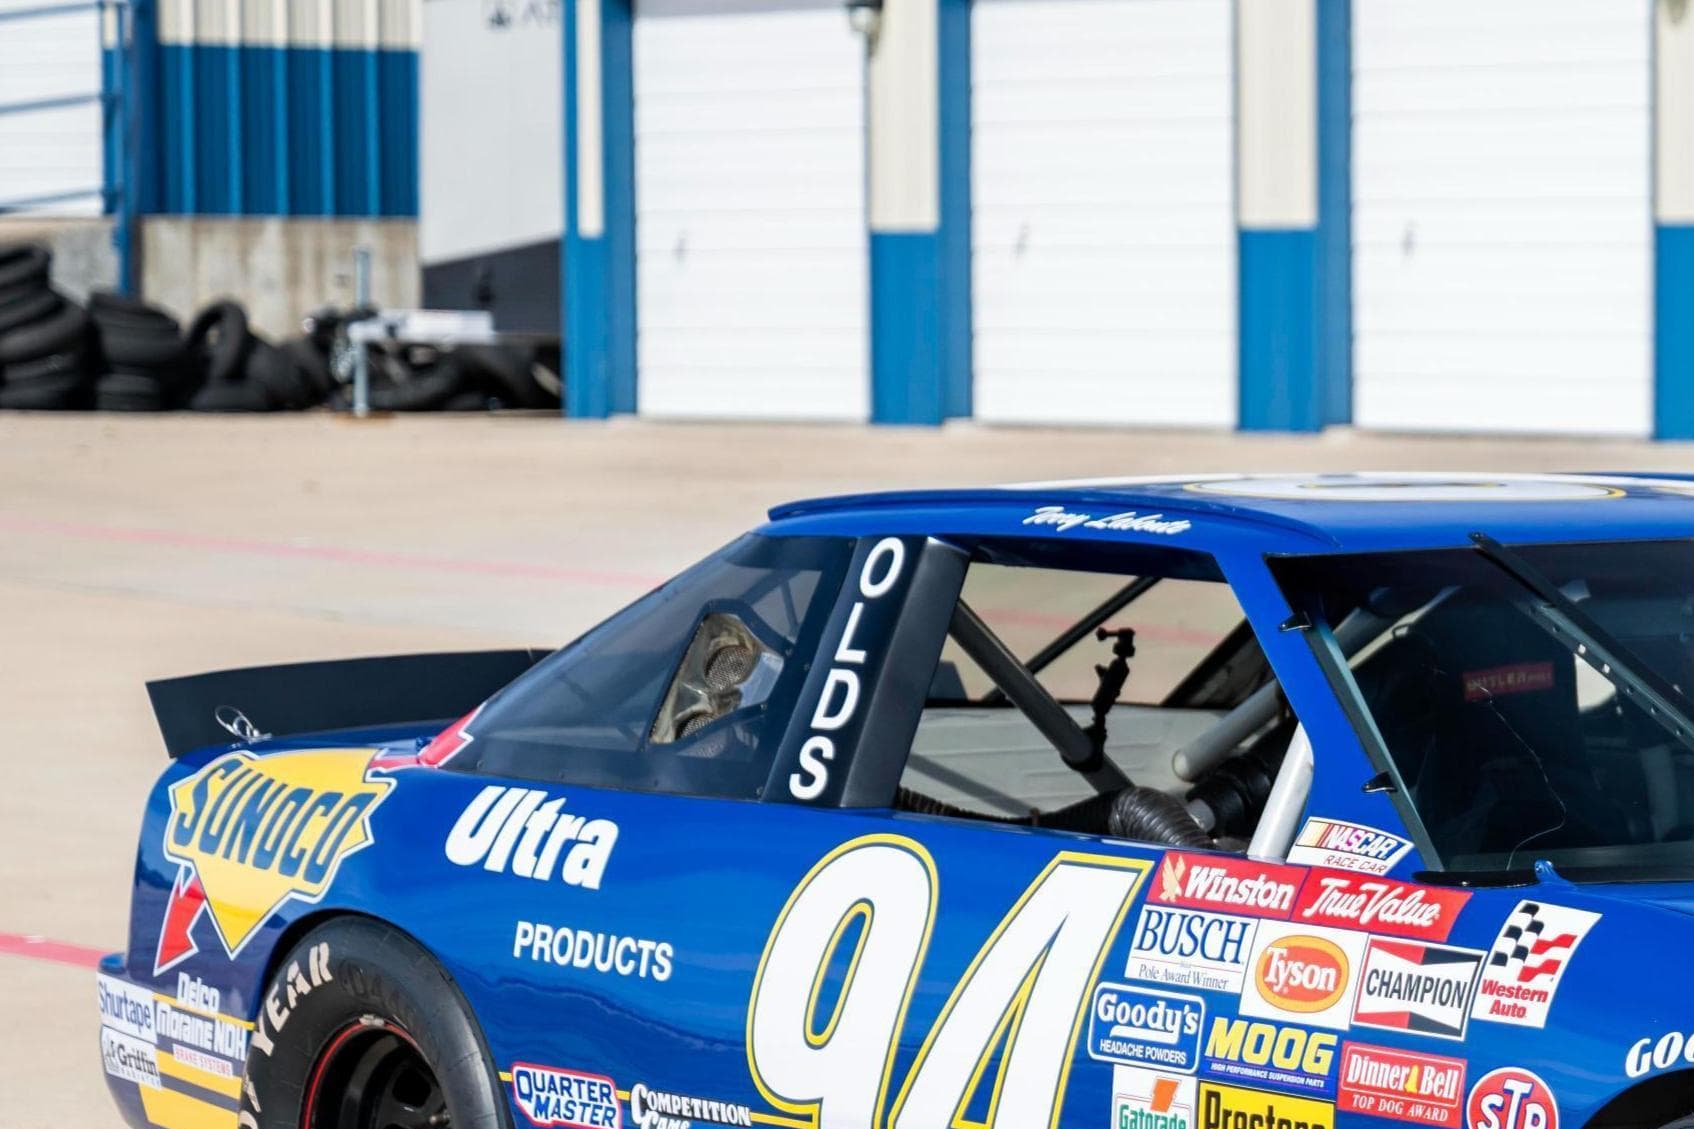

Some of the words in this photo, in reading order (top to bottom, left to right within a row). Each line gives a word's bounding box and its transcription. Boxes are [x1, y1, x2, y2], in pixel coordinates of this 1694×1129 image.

[789, 537, 905, 800] OLDS
[173, 757, 378, 885] SUNOCO
[445, 785, 620, 890] Ultra
[1326, 824, 1398, 860] NASCAR
[1323, 855, 1356, 869] RACE
[1358, 861, 1388, 874] CAR
[1184, 866, 1295, 911] Winston
[1302, 878, 1361, 918] True
[1358, 884, 1441, 927] Value
[513, 921, 674, 982] PRODUCTS
[1134, 909, 1251, 964] BUSCH
[1139, 964, 1159, 978] Pole
[1160, 968, 1191, 985] Award
[1193, 971, 1229, 990] Winner
[1264, 946, 1336, 994] Tyson
[1365, 968, 1468, 1009] CHAMPION
[98, 980, 151, 1033] Shurtape
[177, 972, 220, 1013] Delco
[1481, 979, 1548, 1003] Western
[1489, 1000, 1526, 1018] Auto
[1099, 993, 1198, 1036] Goody's
[117, 1043, 159, 1077] Griffin
[214, 1020, 247, 1061] NDH
[1100, 1039, 1144, 1058] HEADACHE
[1145, 1046, 1187, 1065] POWDERS
[1204, 1017, 1338, 1076] MOOG
[515, 1070, 612, 1104] QUARTER
[1226, 1064, 1268, 1079] PERFORMANCE
[1268, 1071, 1306, 1085] SUSPENSION
[1347, 1054, 1412, 1092] Dinner
[1419, 1065, 1459, 1099] Bell
[533, 1094, 617, 1129] MASTER
[631, 1083, 752, 1126] COMPETITION
[1352, 1094, 1375, 1108] TOP
[1378, 1097, 1404, 1113] DOG
[1407, 1104, 1448, 1122] AWARD
